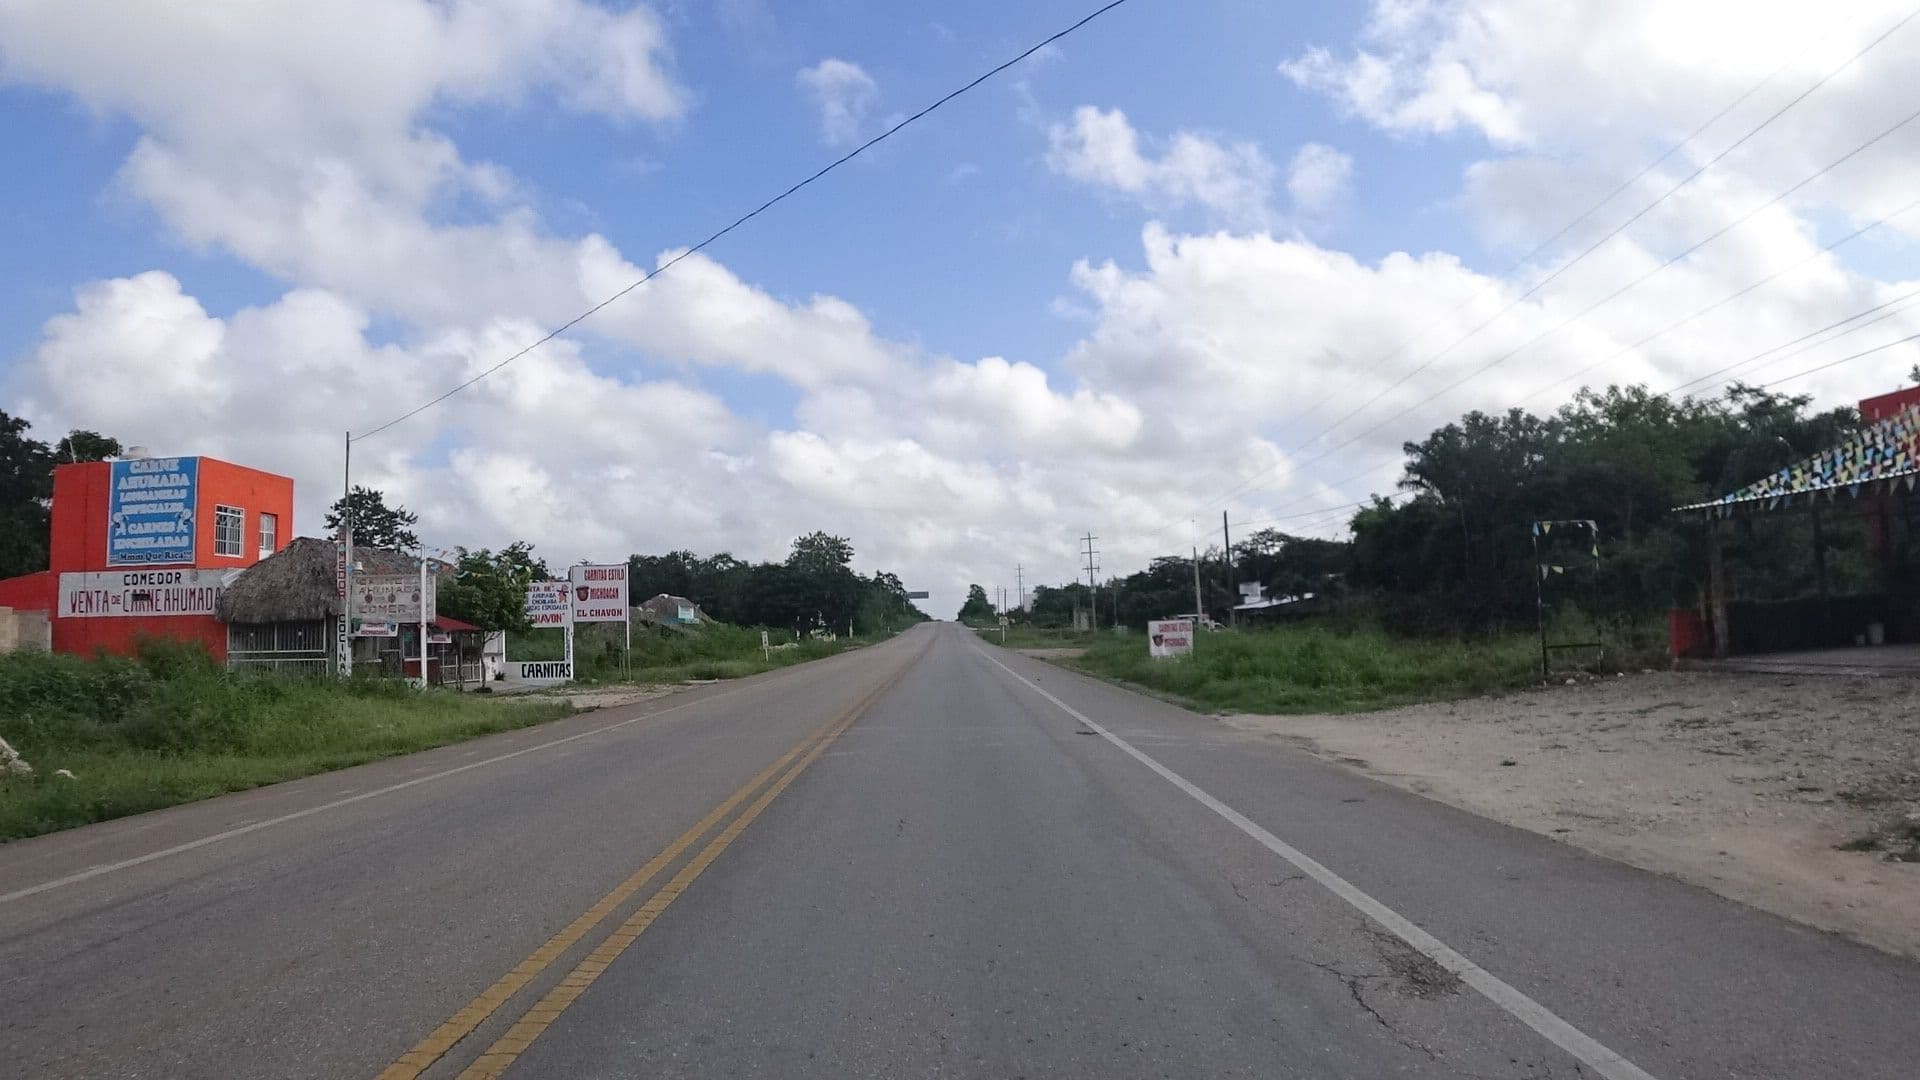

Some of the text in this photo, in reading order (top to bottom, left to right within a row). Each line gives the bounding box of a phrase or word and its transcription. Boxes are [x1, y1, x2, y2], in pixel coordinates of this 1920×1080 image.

[129, 459, 179, 474] CARNE
[118, 473, 190, 490] AHUMADA
[123, 572, 182, 586] COMEDOR
[70, 590, 109, 613] VENTA
[111, 595, 121, 605] DE
[576, 608, 623, 617] EL CHAVON
[338, 613, 346, 671] COCINA
[521, 663, 571, 679] CARNITAS
